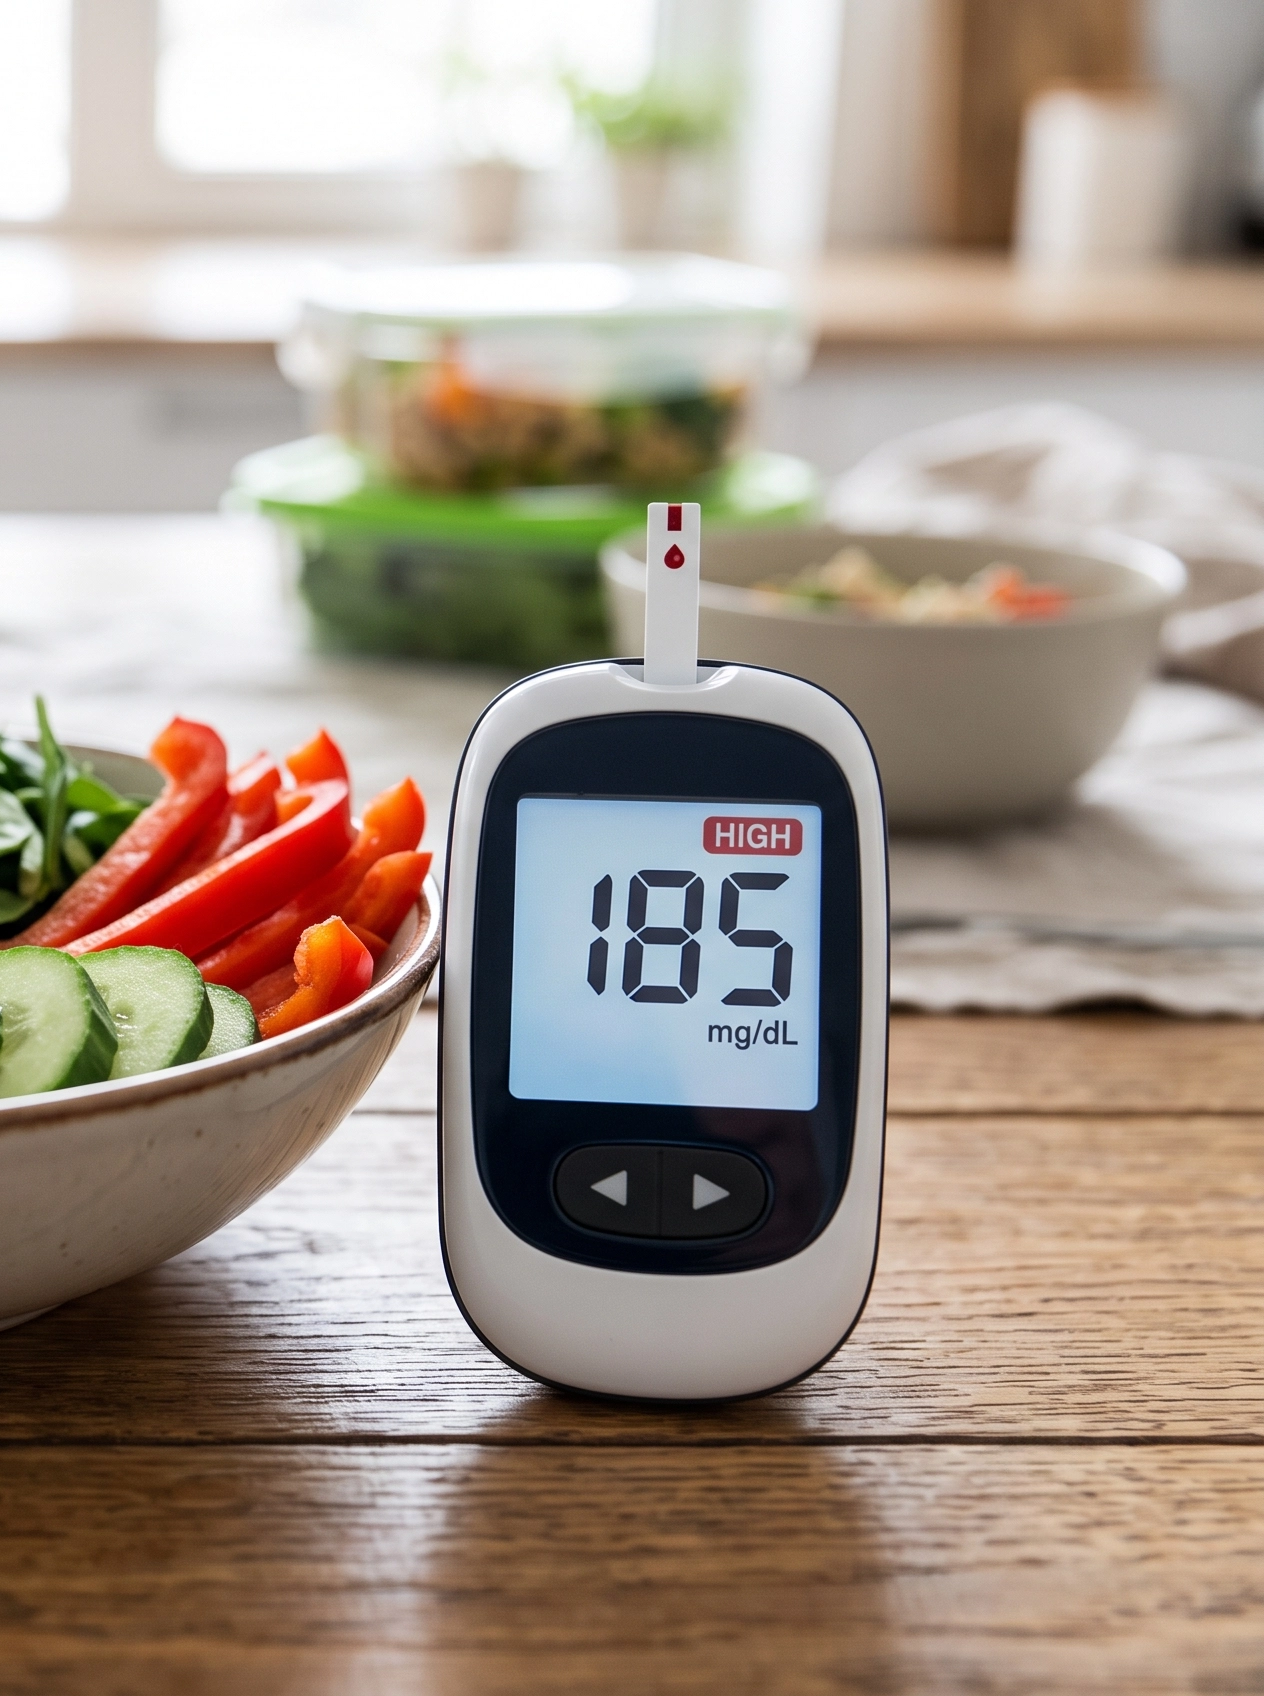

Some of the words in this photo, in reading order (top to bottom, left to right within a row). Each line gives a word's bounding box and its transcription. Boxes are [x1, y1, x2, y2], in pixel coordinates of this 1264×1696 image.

[715, 823, 791, 849] HIGH
[586, 869, 794, 1008] 185
[707, 1019, 799, 1051] mg/dL
